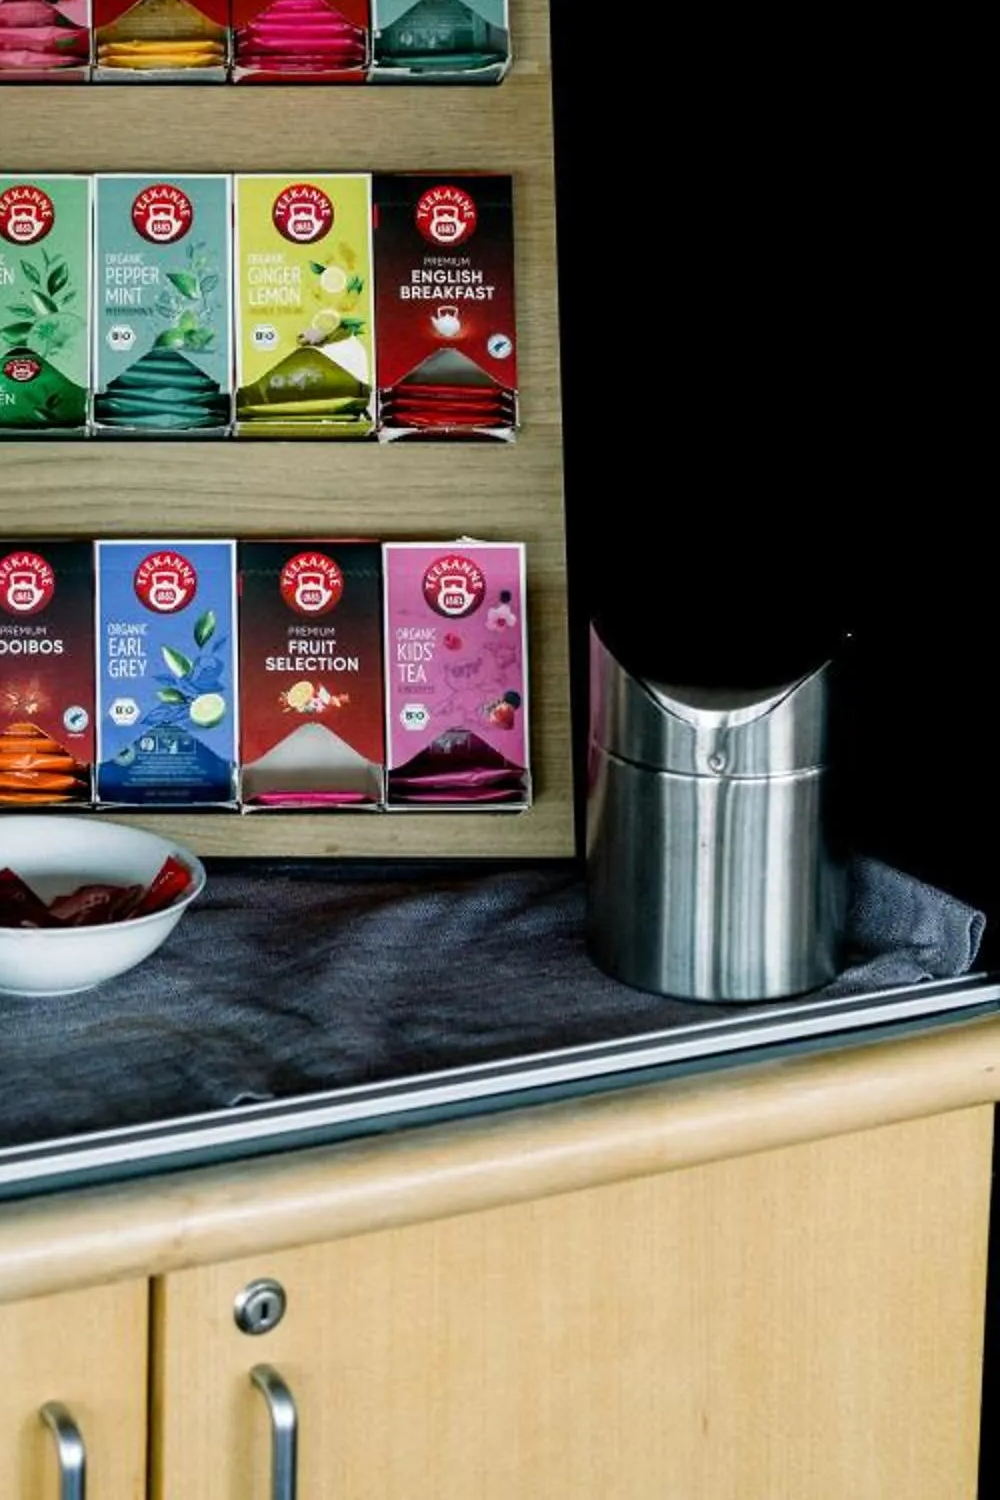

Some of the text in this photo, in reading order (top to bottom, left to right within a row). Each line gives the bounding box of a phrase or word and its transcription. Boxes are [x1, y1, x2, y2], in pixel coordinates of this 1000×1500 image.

[133, 186, 191, 218] TEEKANNE
[275, 186, 332, 218] TEEKANNE
[417, 187, 476, 220] TEEKANNE
[423, 256, 471, 266] PREMIUM
[105, 266, 160, 285] PEPPER
[247, 266, 302, 284] GINGER
[411, 269, 483, 284] ENGLISH
[105, 287, 143, 305] MINT
[248, 286, 302, 305] LEMON
[400, 285, 496, 300] BREAKFAST
[136, 555, 195, 587] TEEKANNE
[283, 555, 341, 588] TEEKANNE
[425, 557, 483, 591] TEEKANNE
[0, 625, 47, 636] PREMIUM
[107, 623, 149, 635] ORGANIC
[288, 626, 335, 636] PREMIUM
[397, 627, 437, 640] ORGANIC
[108, 638, 146, 657] EARL
[288, 640, 337, 655] FRUIT
[108, 659, 147, 678] GREY
[265, 657, 360, 672] SELECTION
[399, 664, 427, 683] TEA
